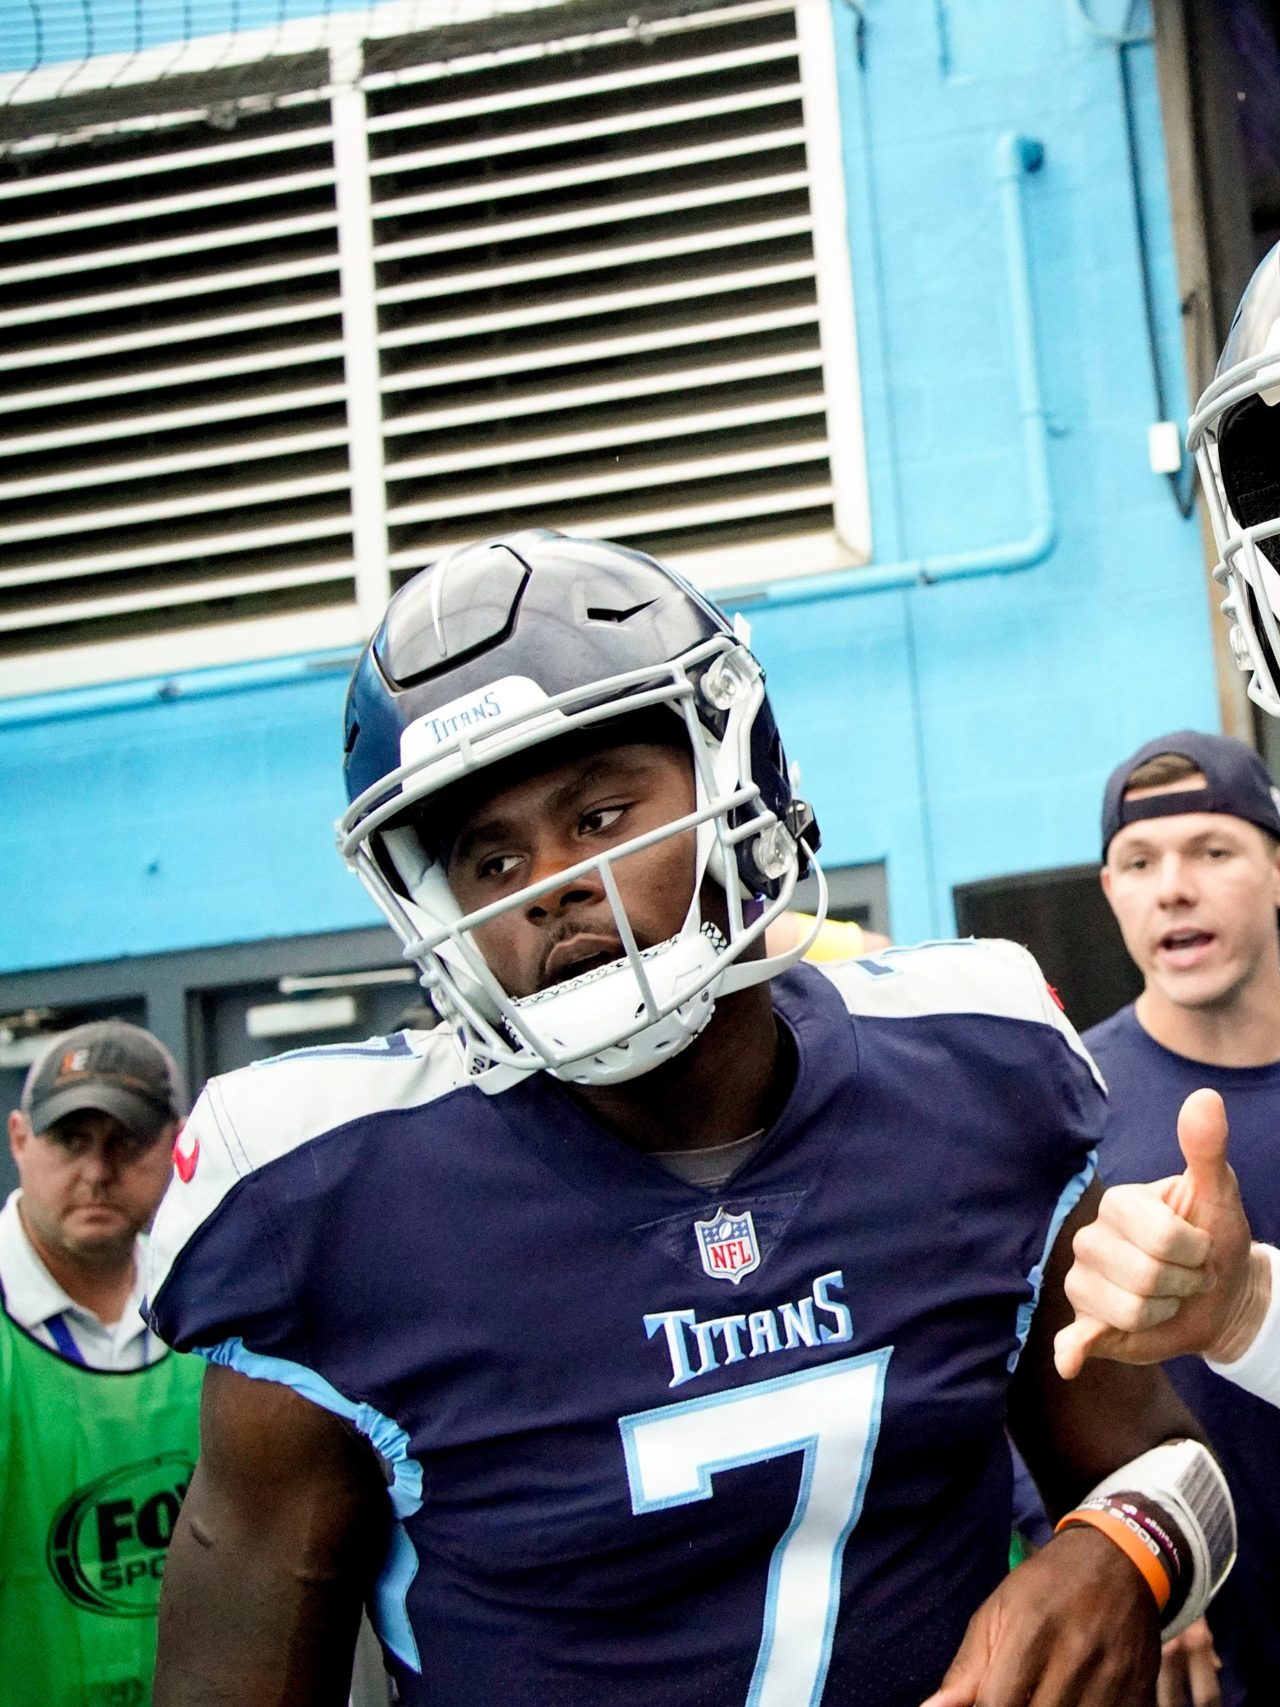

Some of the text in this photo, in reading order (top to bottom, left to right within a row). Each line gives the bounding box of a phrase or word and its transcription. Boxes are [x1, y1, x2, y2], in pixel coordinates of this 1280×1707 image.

[425, 692, 501, 743] TITANS
[710, 1240, 752, 1270] NFL
[643, 1270, 854, 1388] TITANS
[618, 1346, 894, 1707] 7
